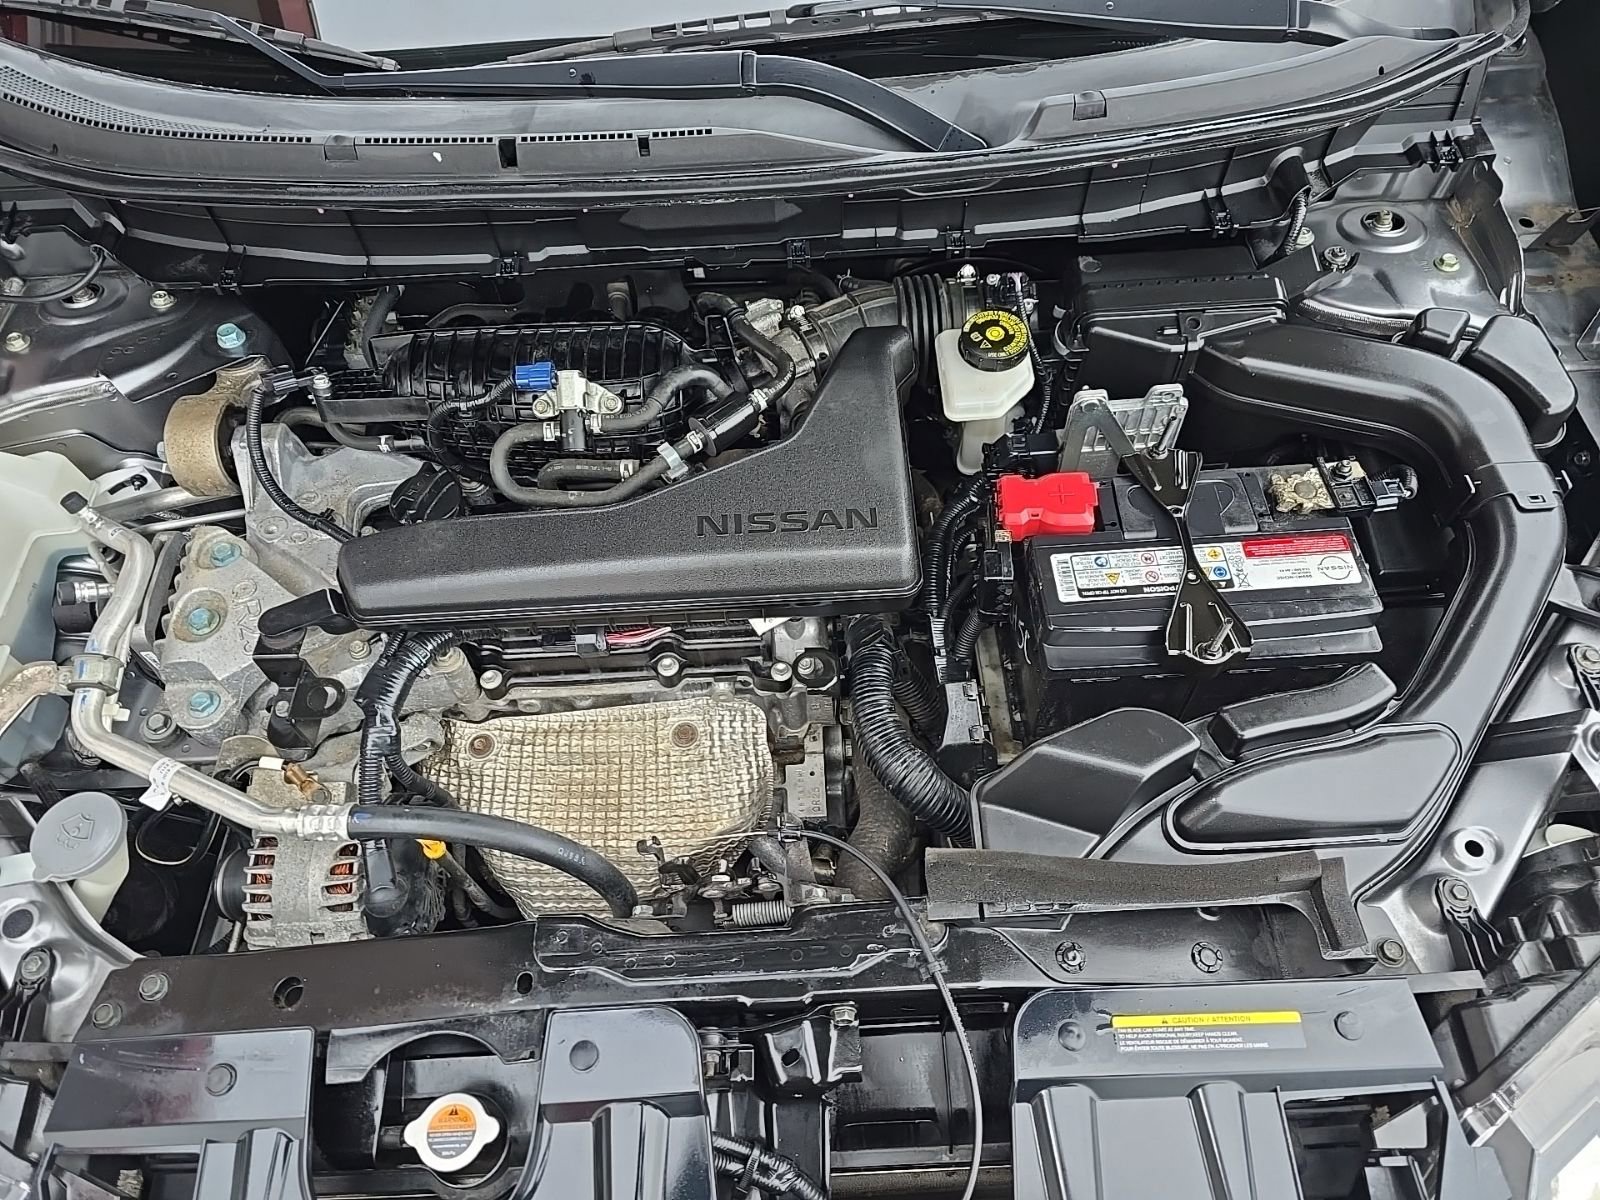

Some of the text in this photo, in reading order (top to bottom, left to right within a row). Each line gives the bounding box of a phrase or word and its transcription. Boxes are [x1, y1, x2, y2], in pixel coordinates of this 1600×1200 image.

[697, 507, 878, 537] NISSAN
[1317, 564, 1353, 572] NISSAN
[1172, 1016, 1205, 1024] CAUTION
[1213, 1015, 1251, 1023] ATTENTION
